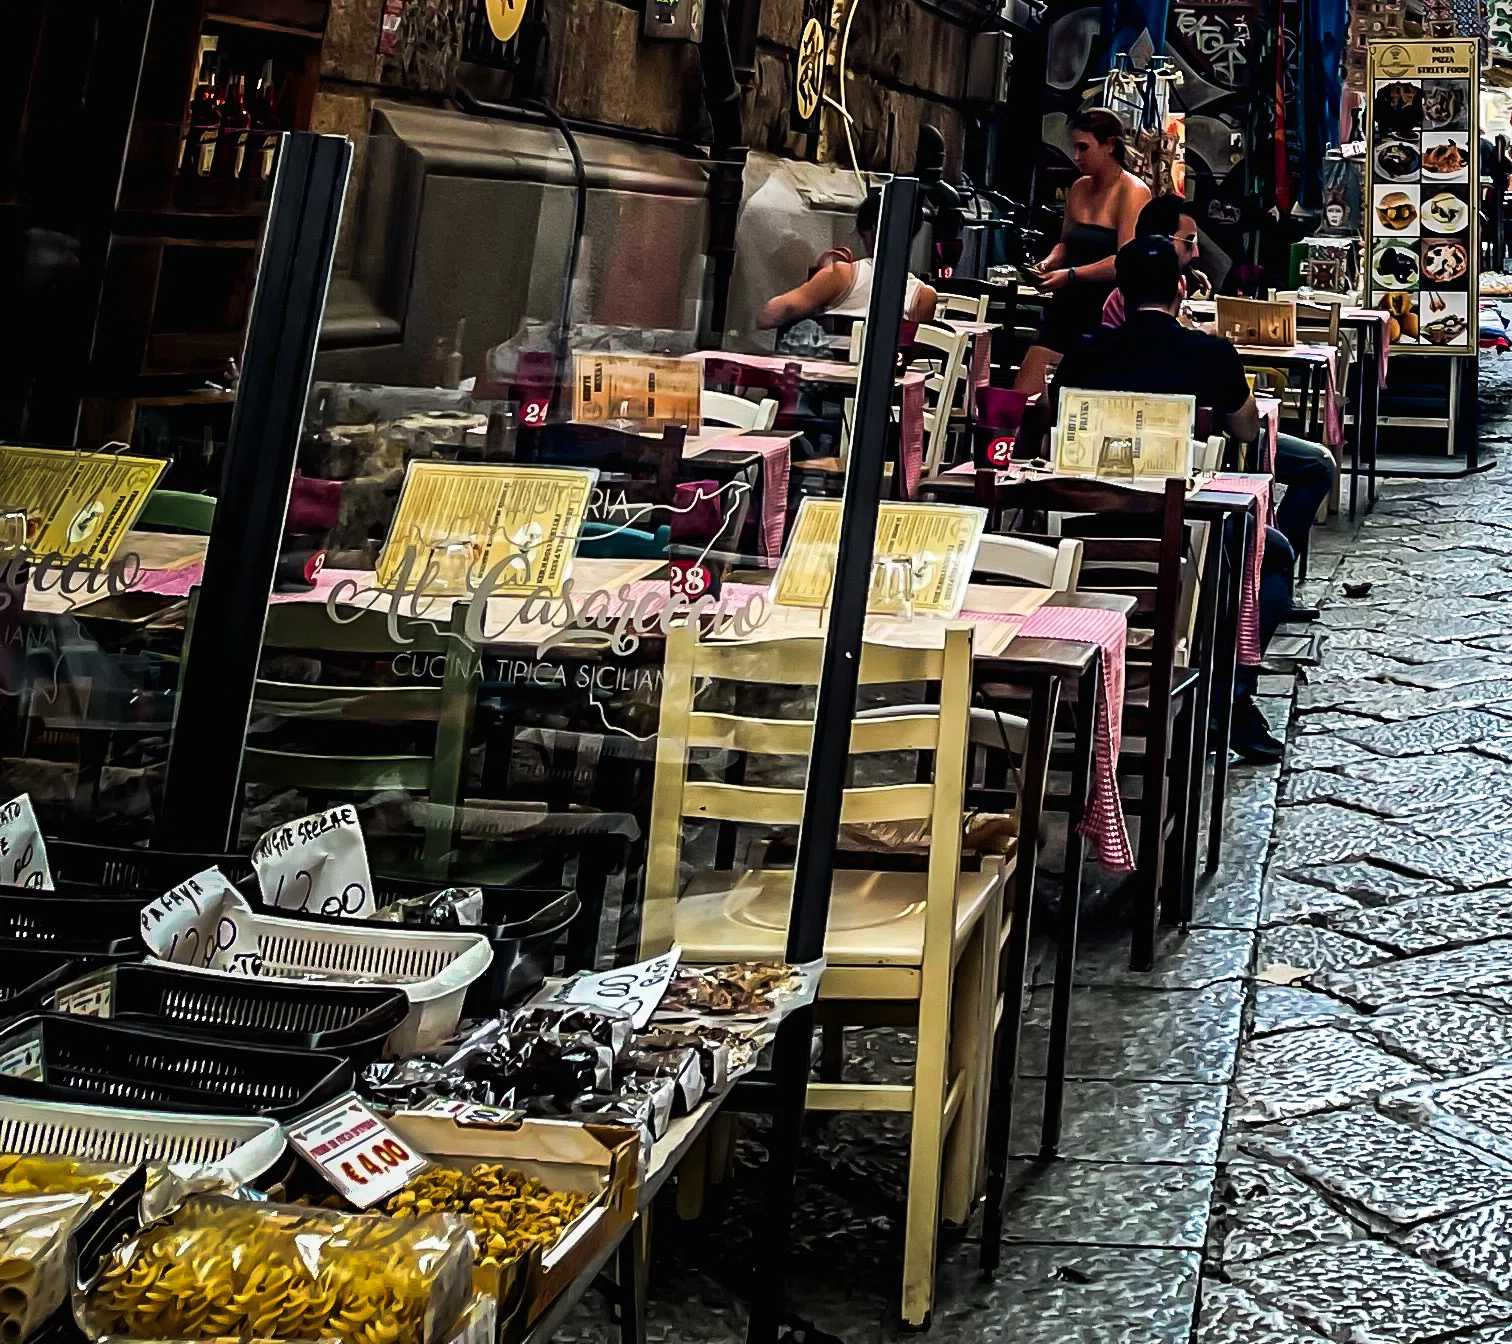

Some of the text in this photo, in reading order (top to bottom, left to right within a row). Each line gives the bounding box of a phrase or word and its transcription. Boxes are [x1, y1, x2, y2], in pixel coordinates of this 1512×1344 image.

[1431, 46, 1455, 54] PASTA
[1431, 56, 1455, 64] PIZZA
[1417, 66, 1469, 74] STREET FOOD
[670, 565, 705, 595] 28
[326, 545, 772, 658] Al Casareccio
[391, 652, 675, 693] CUCINA TIPICA SICILIAN
